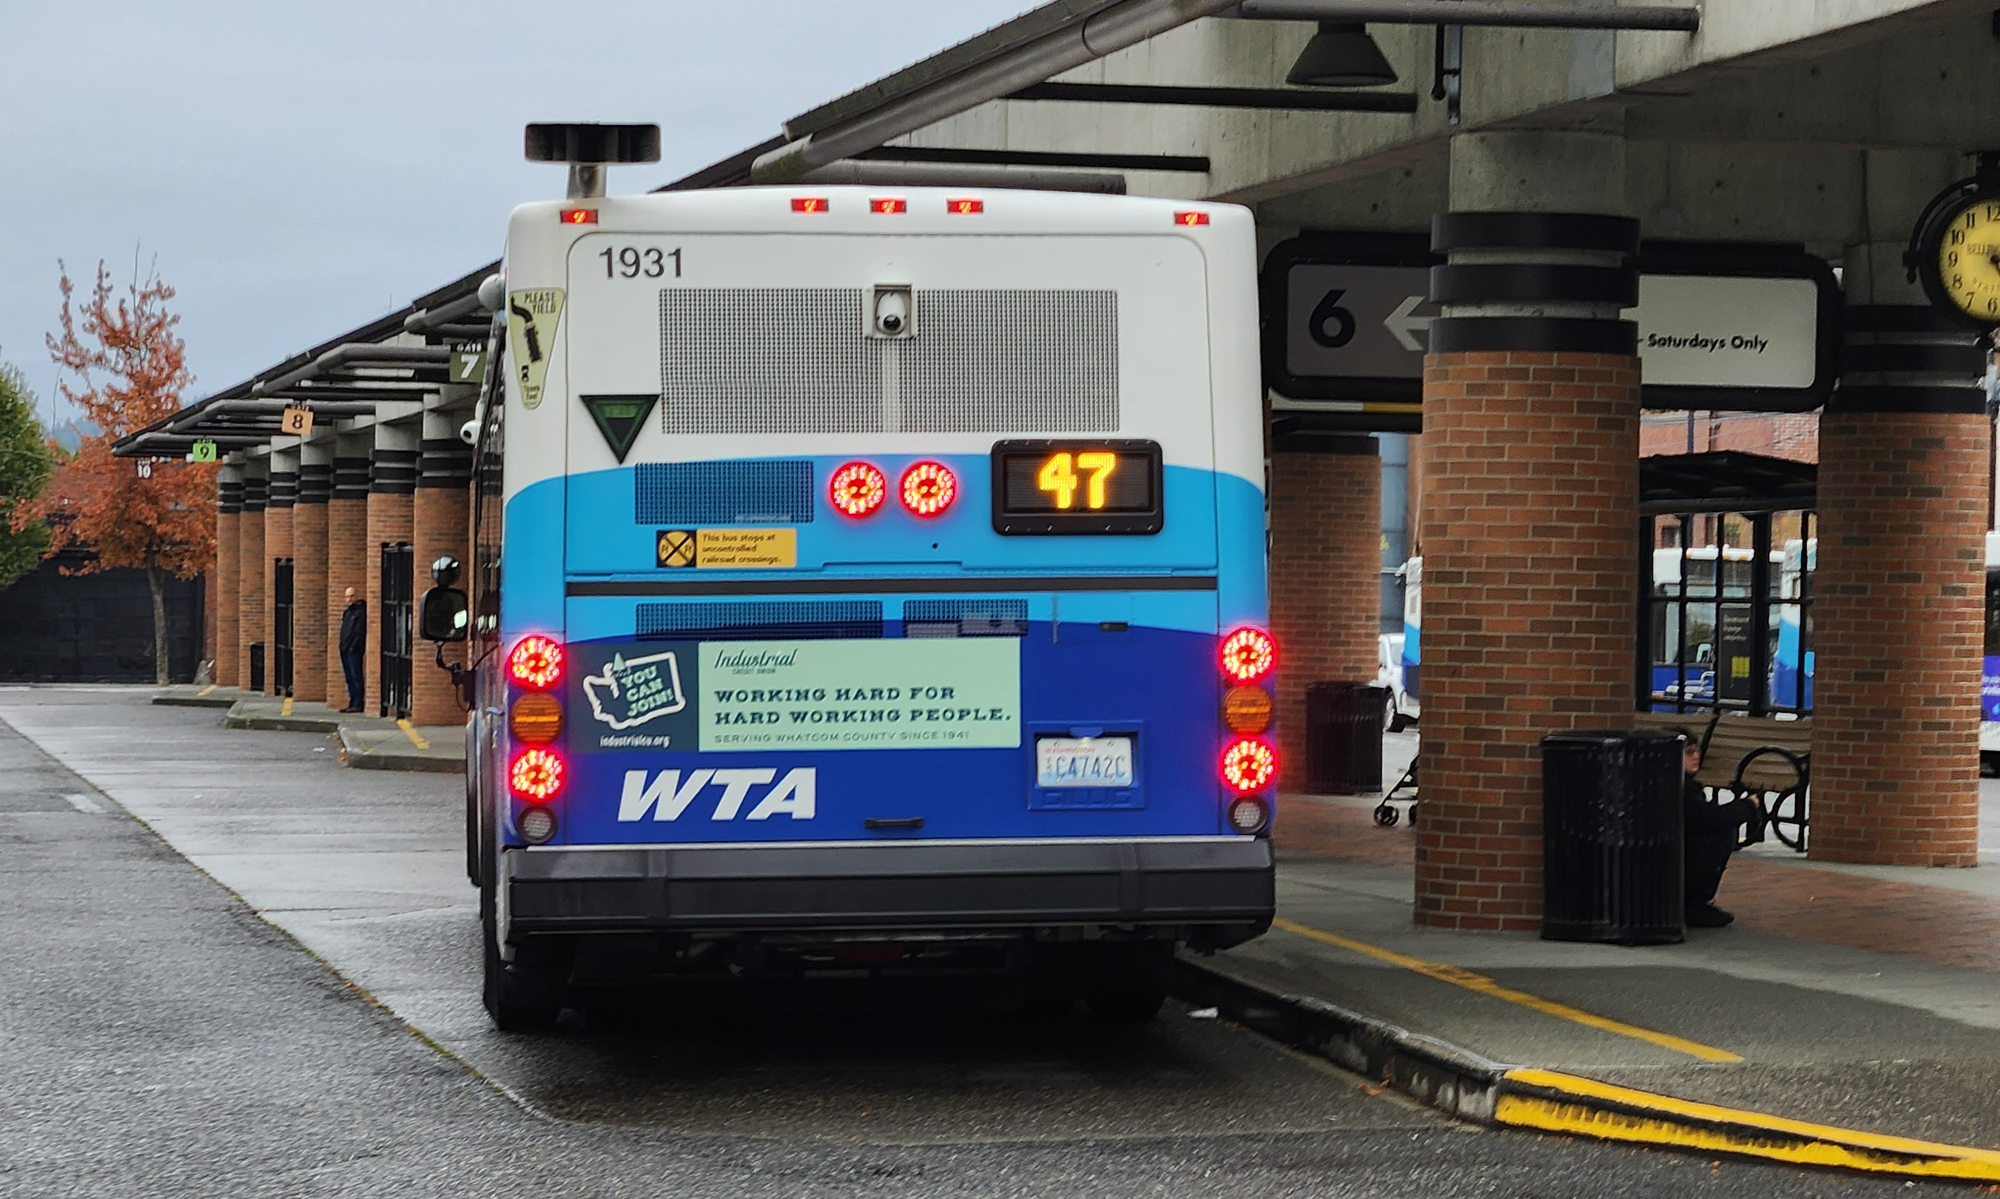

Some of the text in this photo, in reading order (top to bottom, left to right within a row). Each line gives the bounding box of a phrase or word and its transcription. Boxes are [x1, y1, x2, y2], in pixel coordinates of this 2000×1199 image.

[1966, 213, 1975, 229] 11
[1951, 229, 1965, 246] 10
[599, 247, 682, 278] 1931
[1948, 251, 1958, 267] 9
[1952, 274, 1963, 289] 8
[524, 292, 556, 304] PLEASE
[1965, 291, 1975, 310] 7
[1987, 297, 1997, 315] 6
[533, 301, 556, 314] YIELD
[1309, 289, 1356, 348] 6
[1648, 332, 1769, 354] Saturdays Only
[461, 354, 479, 379] 7
[292, 414, 303, 429] 8
[200, 446, 210, 459] 9
[137, 464, 151, 479] 10
[1039, 453, 1117, 509] 47
[703, 534, 719, 542] This
[722, 534, 738, 542] bus
[740, 534, 764, 543] stops
[702, 544, 757, 552] uncontrolled
[702, 554, 735, 563] railroad
[714, 648, 798, 669] Industrial
[620, 665, 657, 688] YOU
[626, 678, 663, 702] CAN
[714, 686, 955, 703] WORKING HARD FOR
[627, 688, 674, 717] JOIN!
[715, 707, 1012, 725] HARD WORKING PEOPLE.
[714, 730, 970, 743] SERVING WHATCOM COUNTY SINCE 1941
[617, 767, 816, 822] WTA
